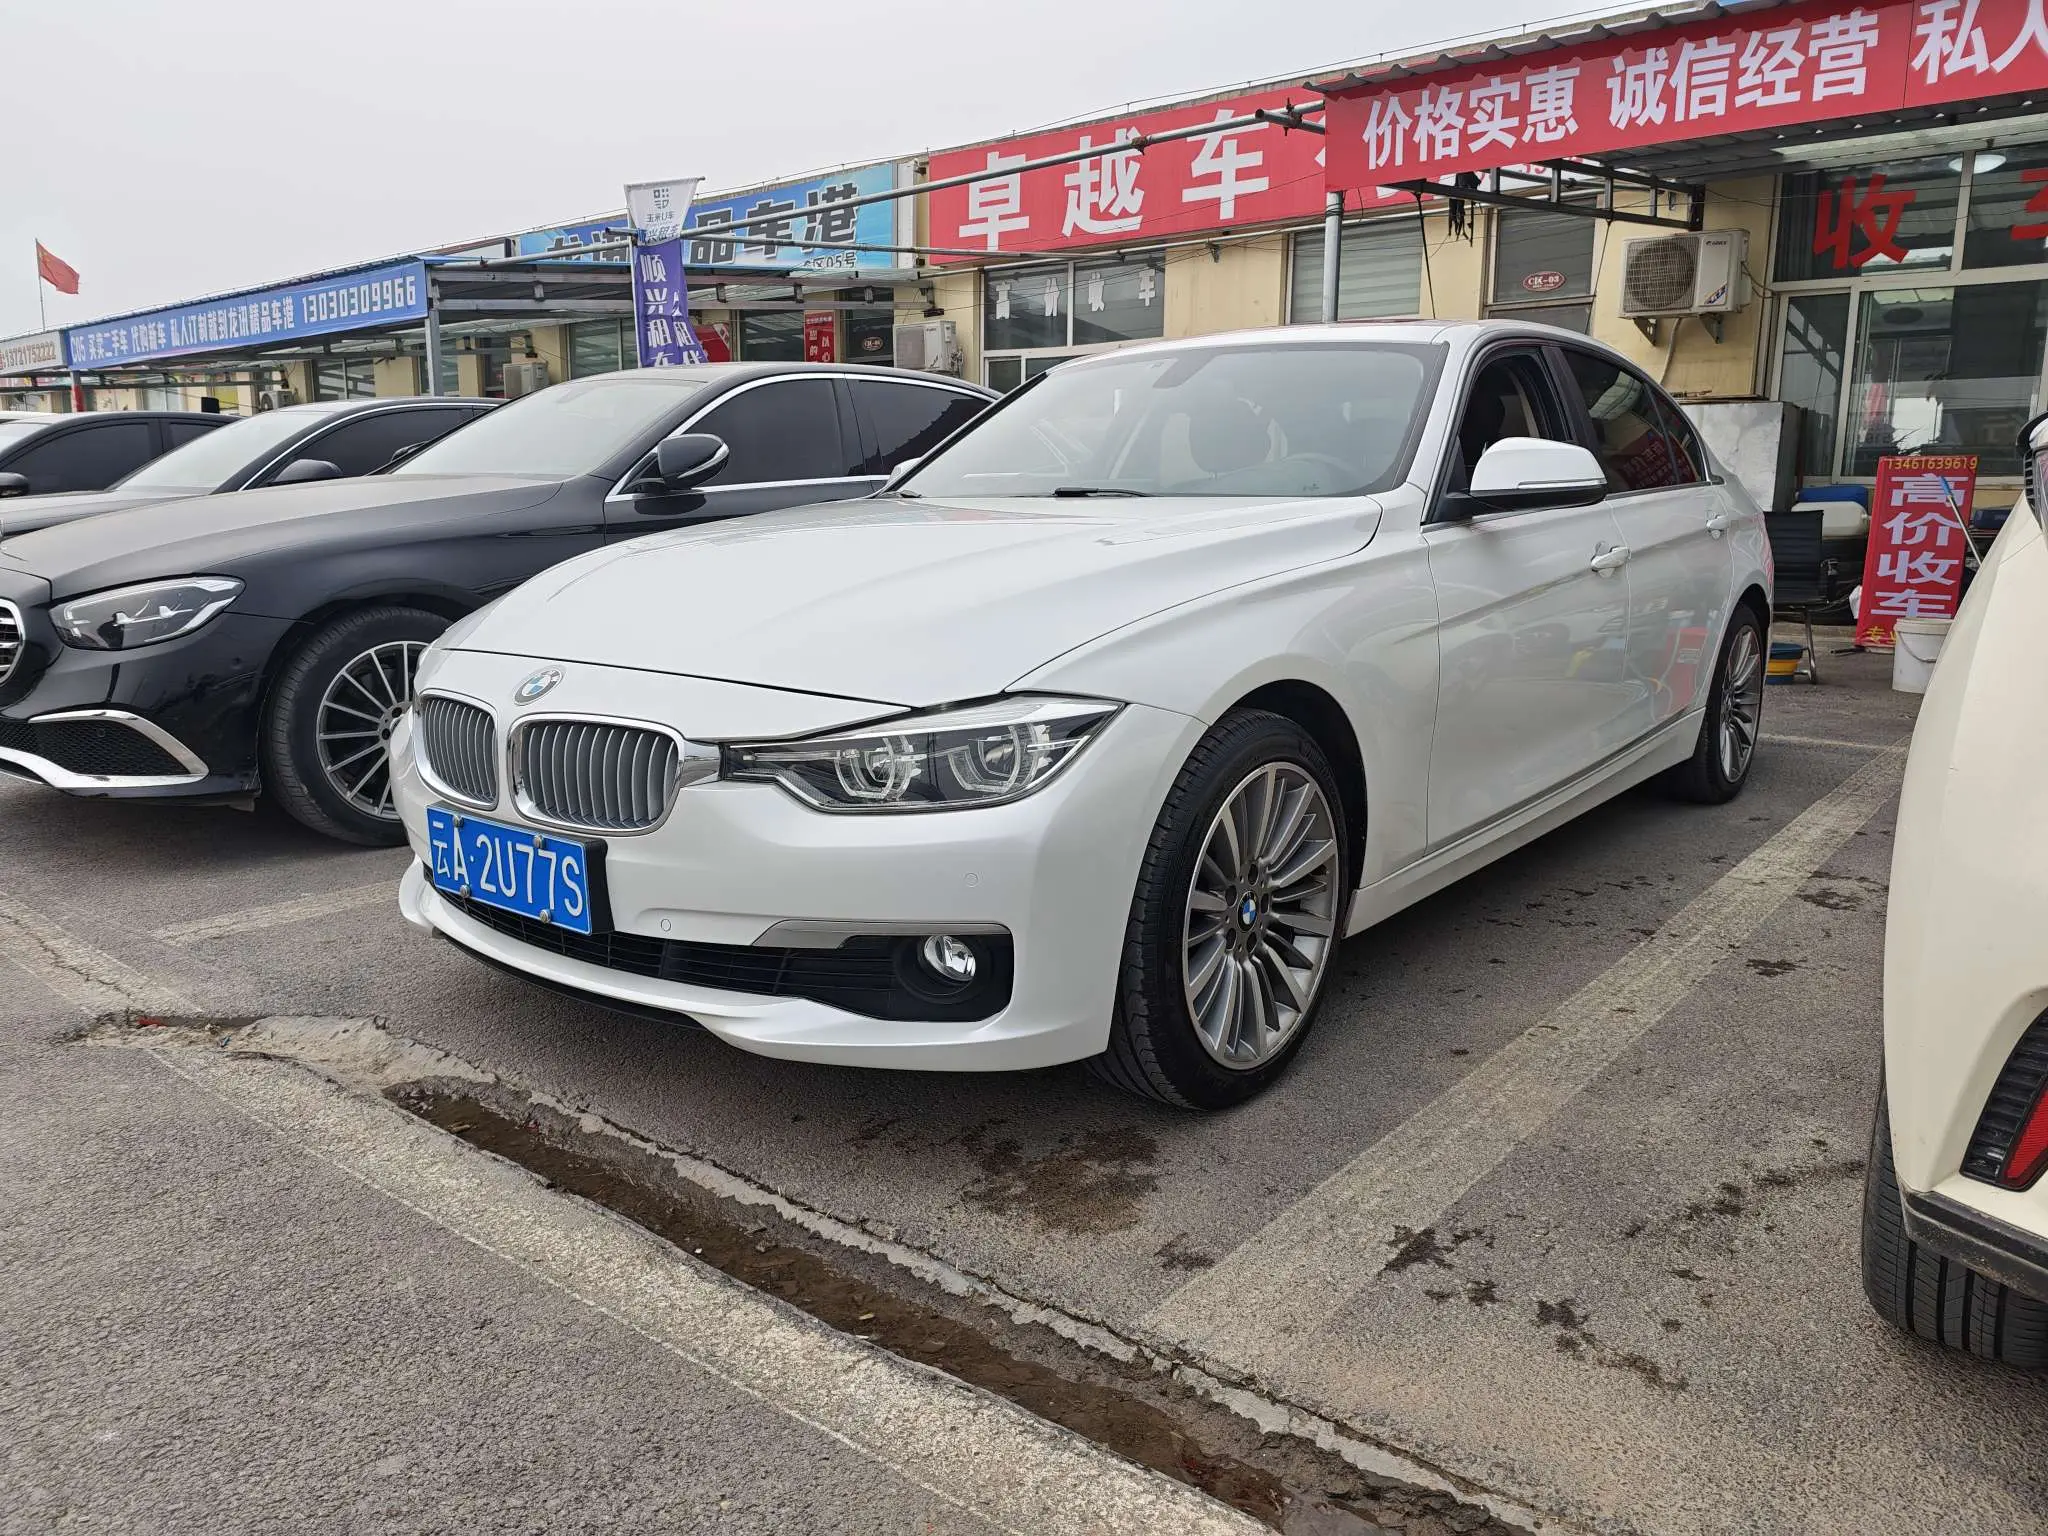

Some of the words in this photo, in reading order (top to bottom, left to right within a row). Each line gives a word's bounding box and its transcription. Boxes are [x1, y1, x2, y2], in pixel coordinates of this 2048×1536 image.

[1362, 64, 1581, 170] 价格实惠
[1606, 10, 1879, 130] 诚信经营
[958, 108, 1326, 252] 卓越车
[88, 328, 129, 360] 买卖二手车
[302, 275, 416, 324] 13030309966
[1888, 456, 1979, 471] 13461639619
[1870, 472, 1970, 619] 高价收车
